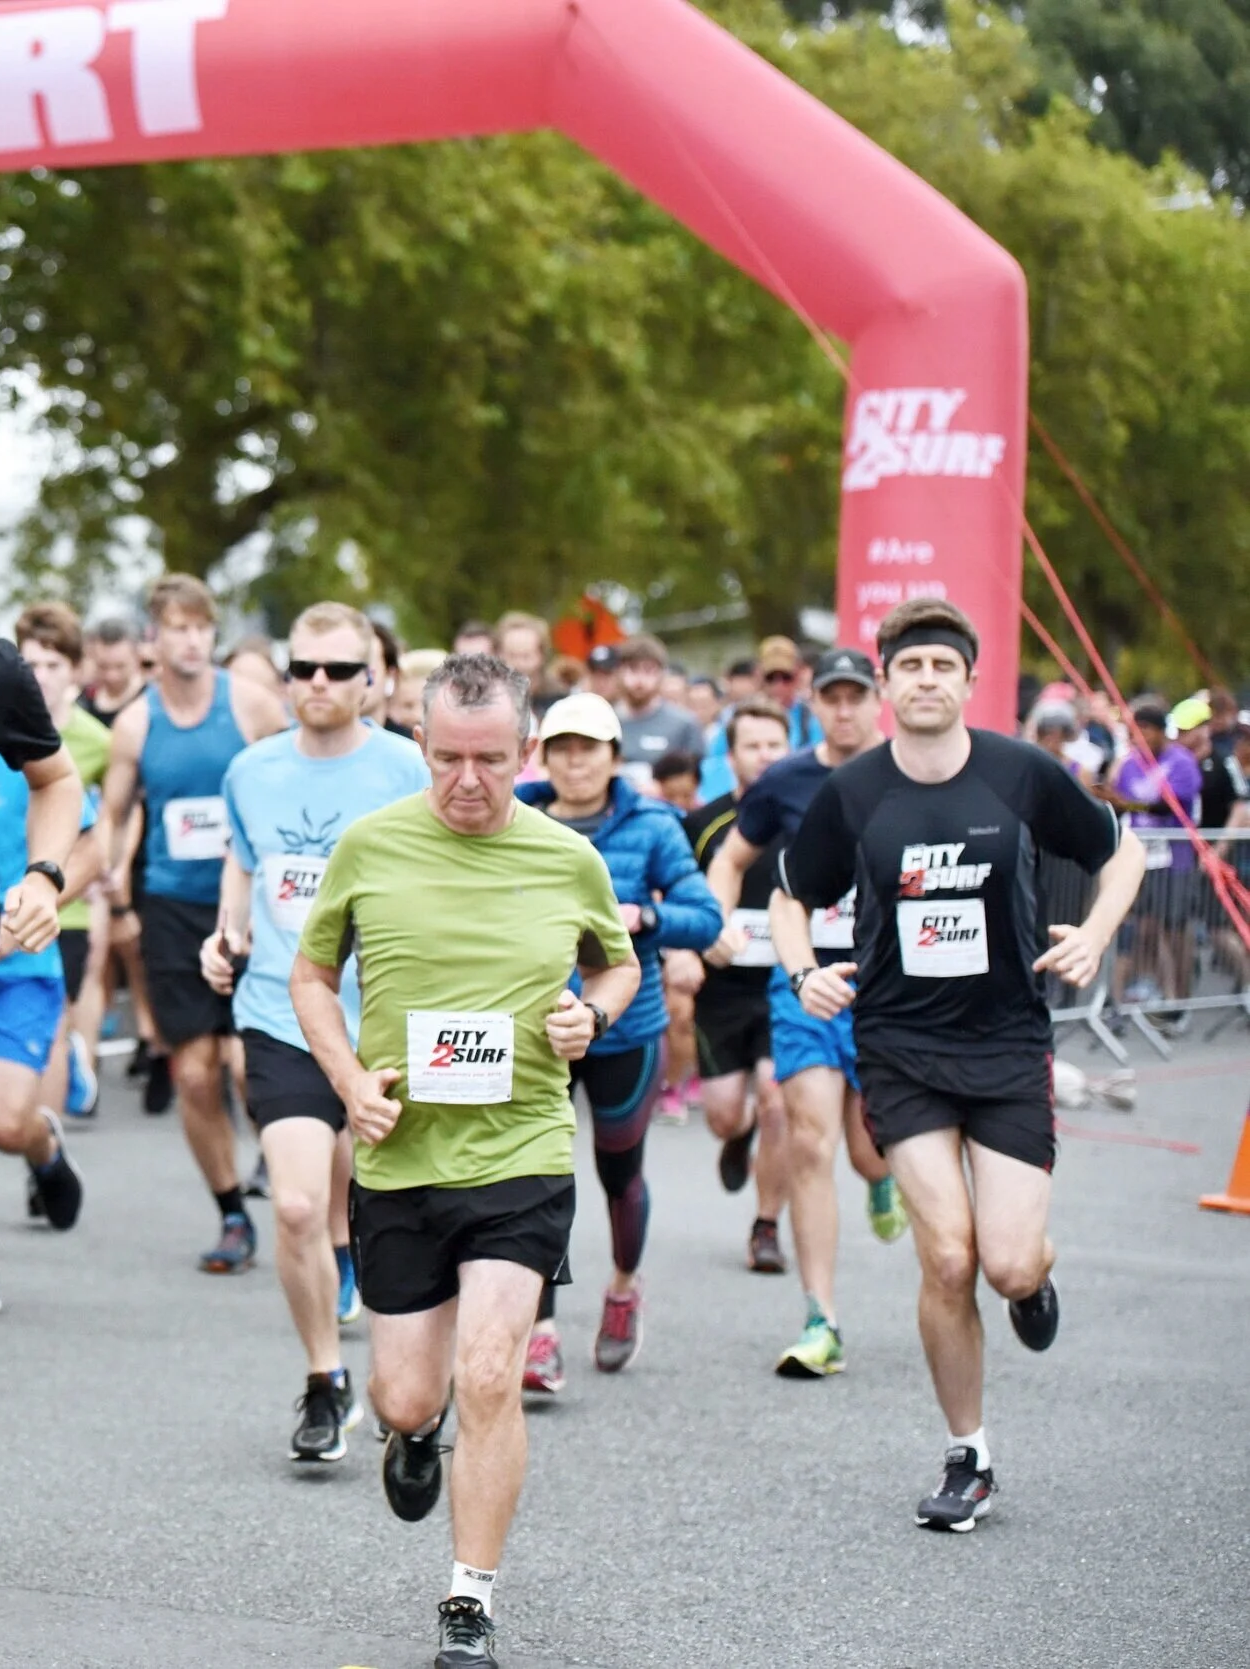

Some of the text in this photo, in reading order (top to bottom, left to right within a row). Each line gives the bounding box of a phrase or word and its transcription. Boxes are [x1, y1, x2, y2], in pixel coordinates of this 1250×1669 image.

[851, 387, 966, 432] CITY
[901, 843, 966, 869] CITY
[922, 915, 962, 930] CITY
[437, 1030, 488, 1046] CITY
